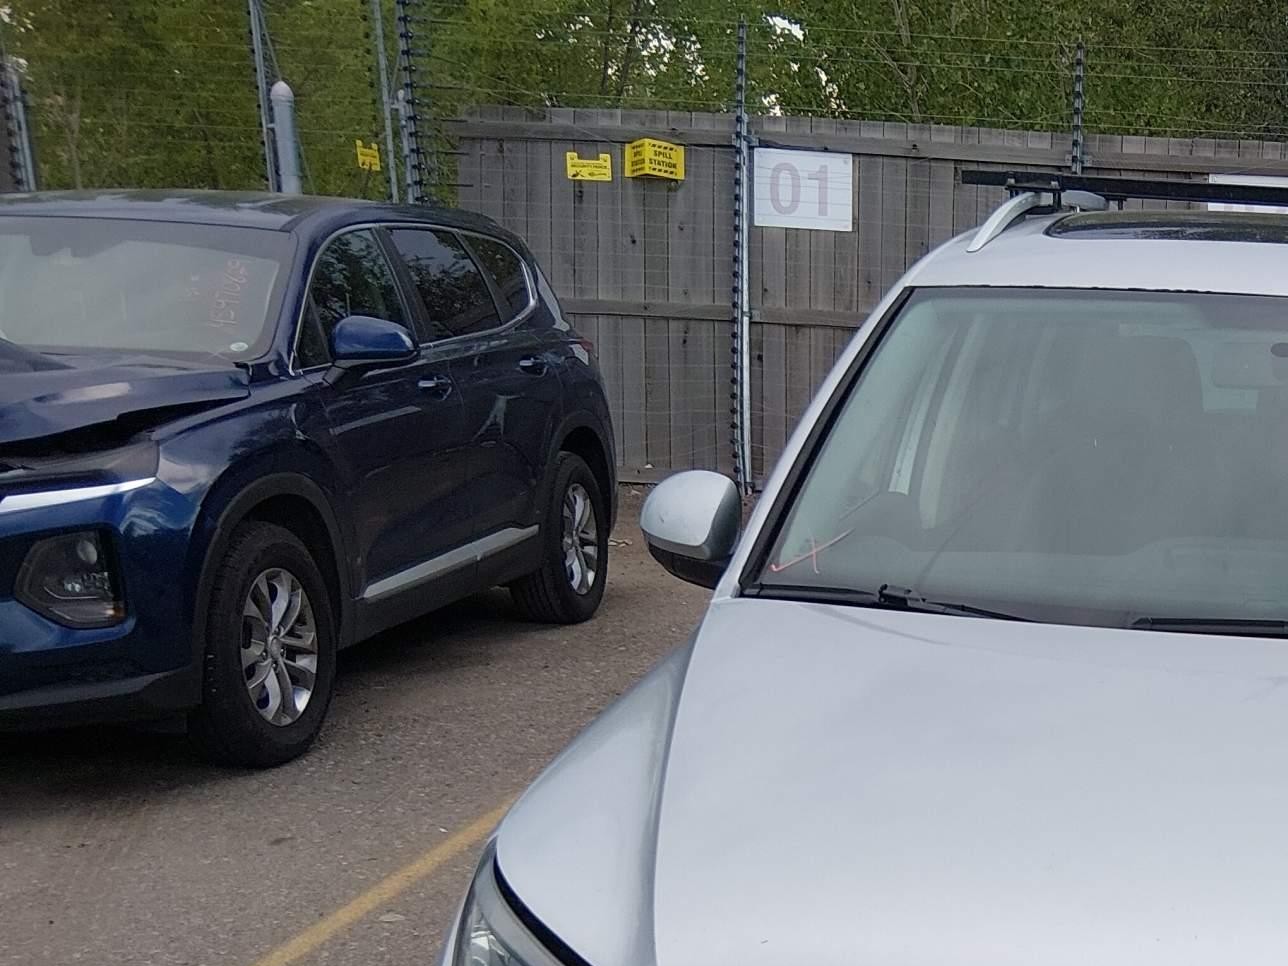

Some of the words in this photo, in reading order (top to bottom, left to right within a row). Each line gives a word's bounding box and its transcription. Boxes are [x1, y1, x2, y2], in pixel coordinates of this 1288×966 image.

[653, 150, 673, 160] SPILL
[649, 158, 677, 169] STATION
[769, 162, 829, 217] 01
